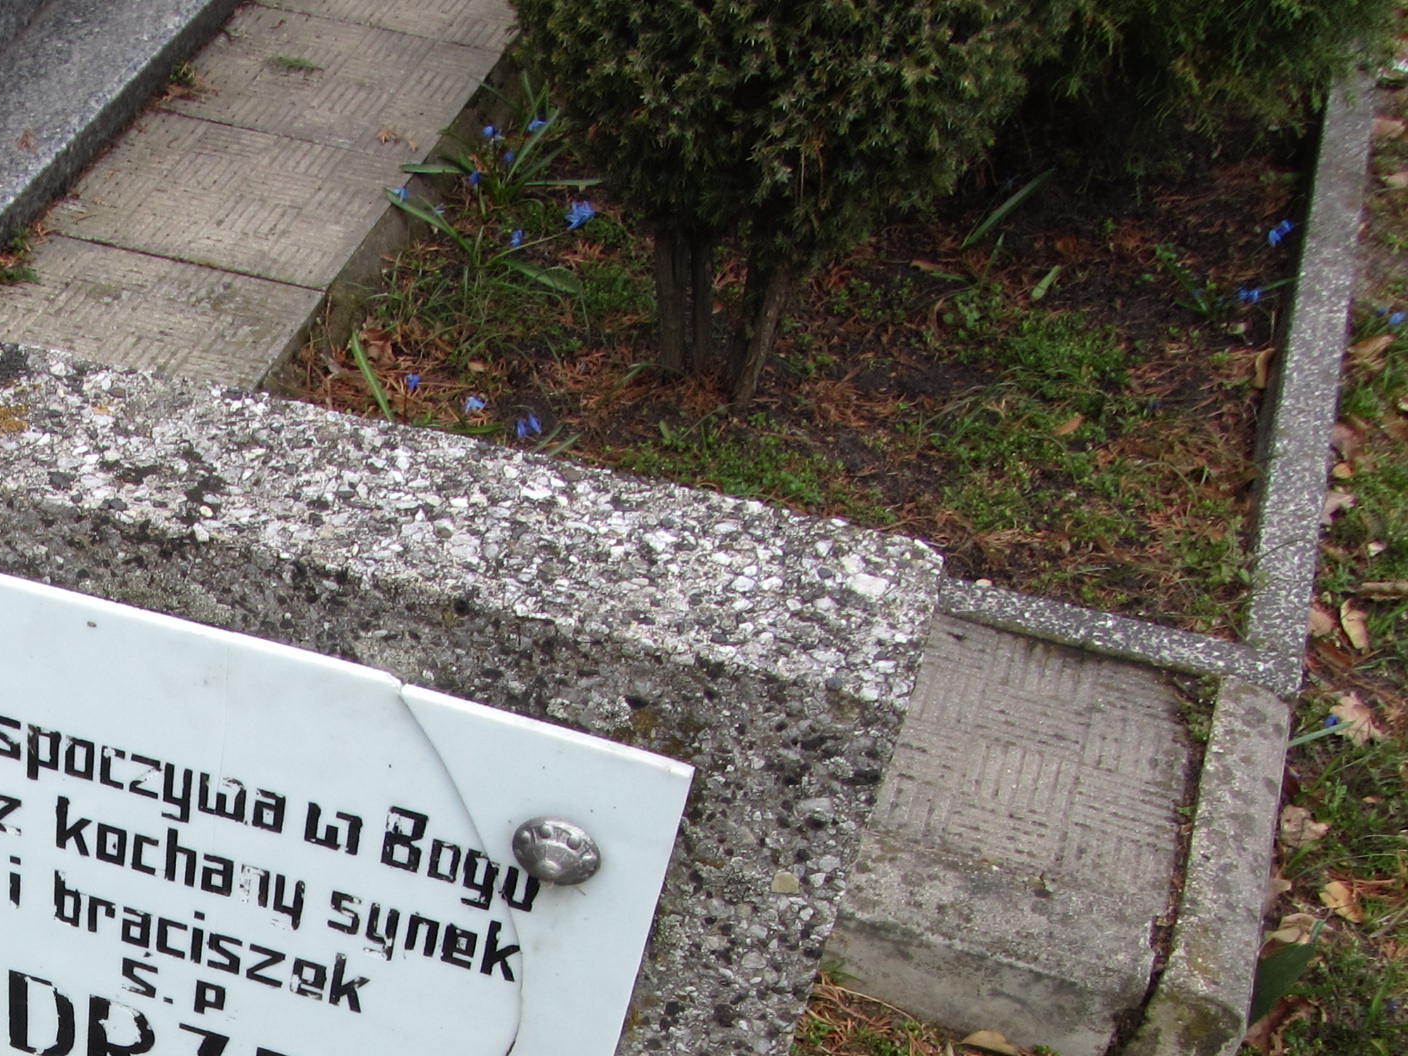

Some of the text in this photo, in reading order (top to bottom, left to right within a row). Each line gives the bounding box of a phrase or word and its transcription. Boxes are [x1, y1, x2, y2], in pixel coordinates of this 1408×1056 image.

[9, 855, 371, 1014] i braciszek
[55, 795, 306, 931] kochany
[327, 889, 522, 982] synek
[303, 801, 364, 856] w
[380, 805, 541, 912] Bogu
